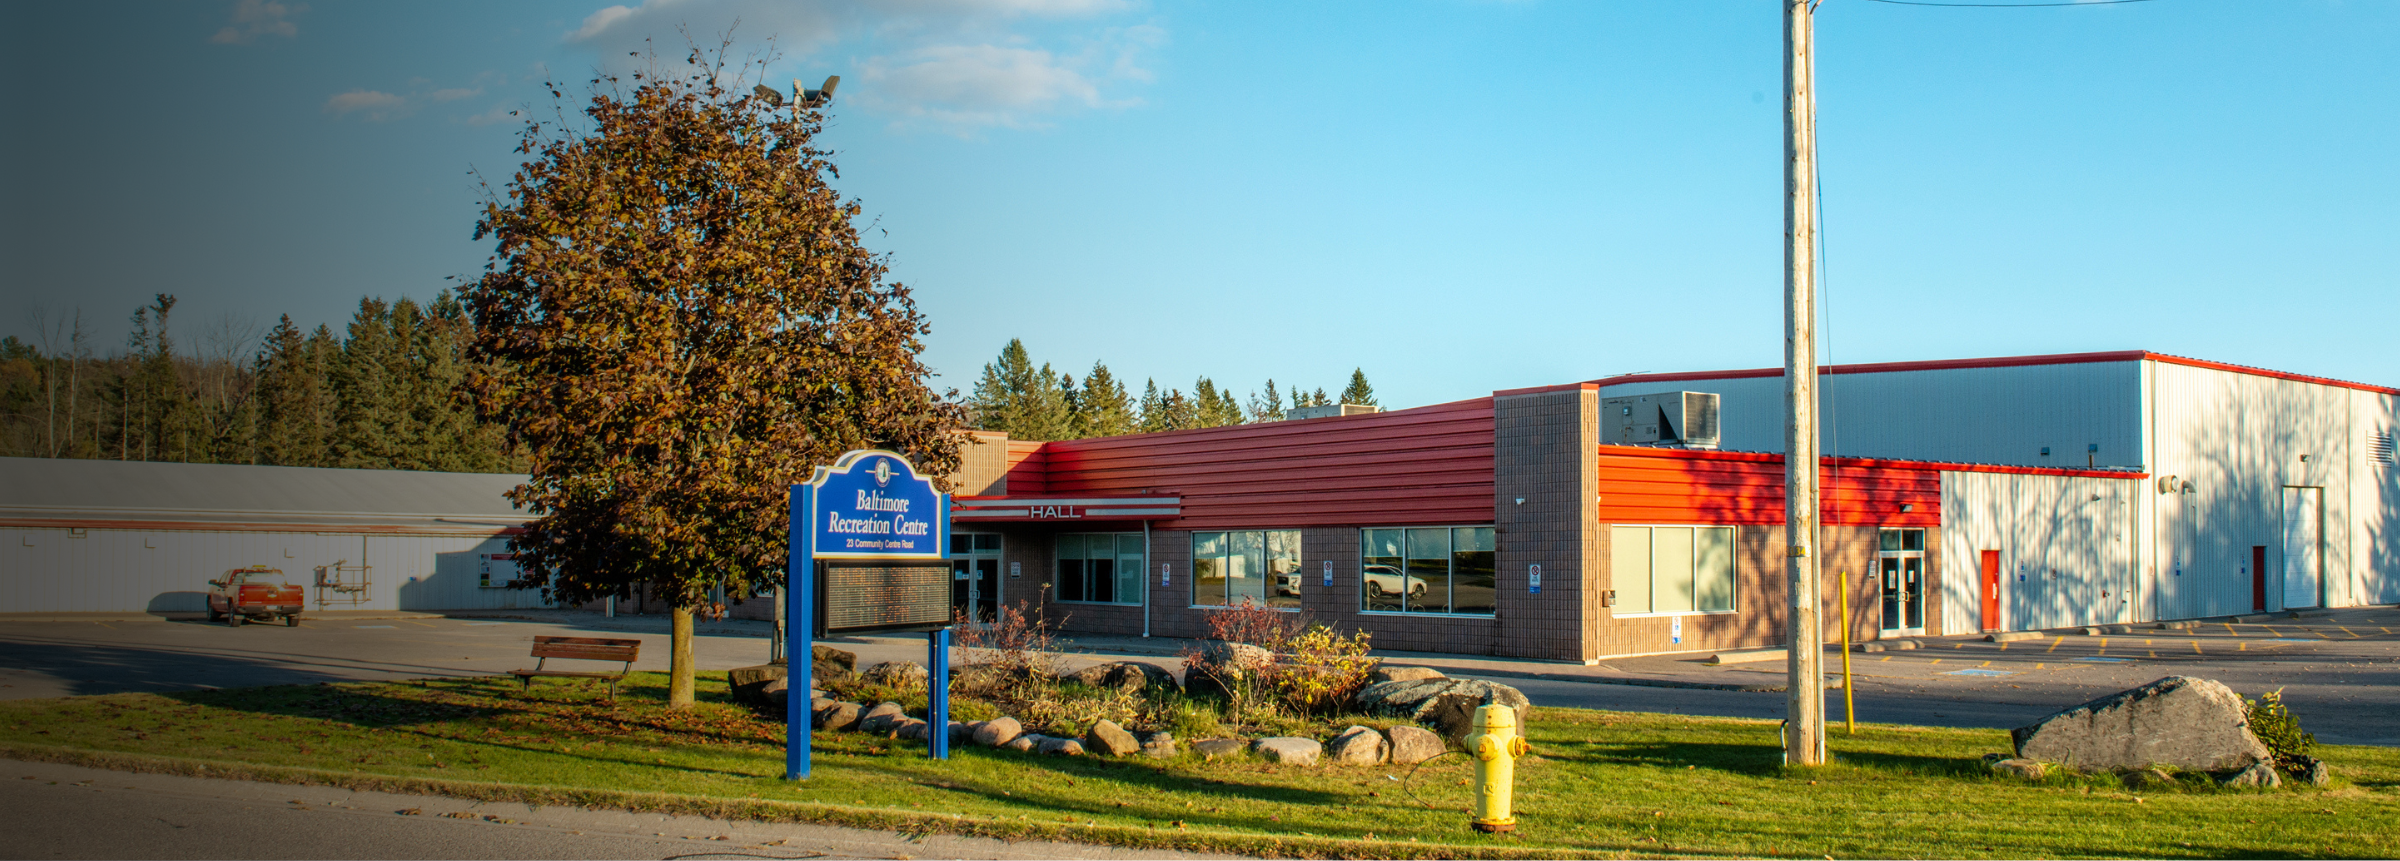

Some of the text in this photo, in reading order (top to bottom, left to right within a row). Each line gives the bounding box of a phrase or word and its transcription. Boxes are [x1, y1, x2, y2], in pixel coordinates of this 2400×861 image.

[856, 489, 910, 512] Baltimore
[1031, 505, 1081, 518] HALL
[828, 511, 928, 535] Recreation Centre
[846, 538, 914, 550] 23 Community Centre Road
[873, 606, 910, 624] 1-2PM
